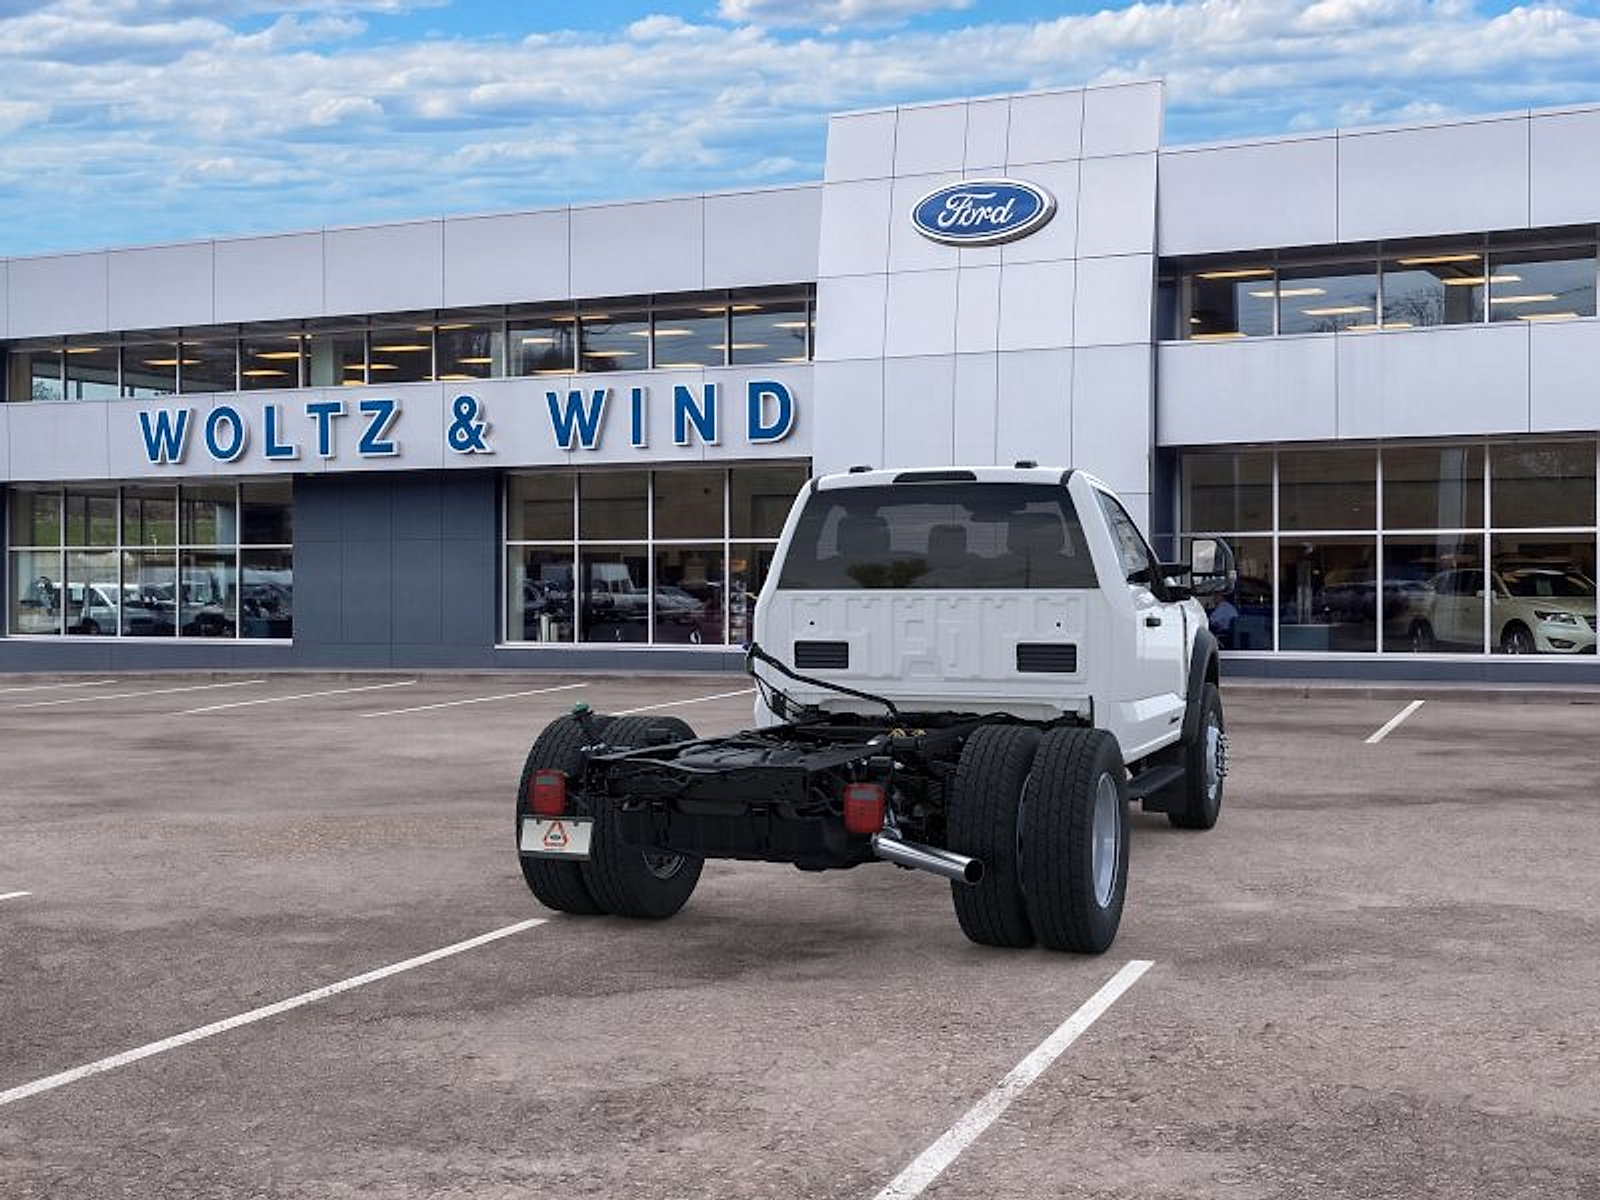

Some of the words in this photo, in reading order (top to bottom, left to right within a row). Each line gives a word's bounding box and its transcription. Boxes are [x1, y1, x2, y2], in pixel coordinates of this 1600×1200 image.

[937, 191, 1015, 228] Ford
[138, 397, 404, 464] WOLTZ
[448, 394, 494, 456] &
[546, 379, 796, 450] WIND
